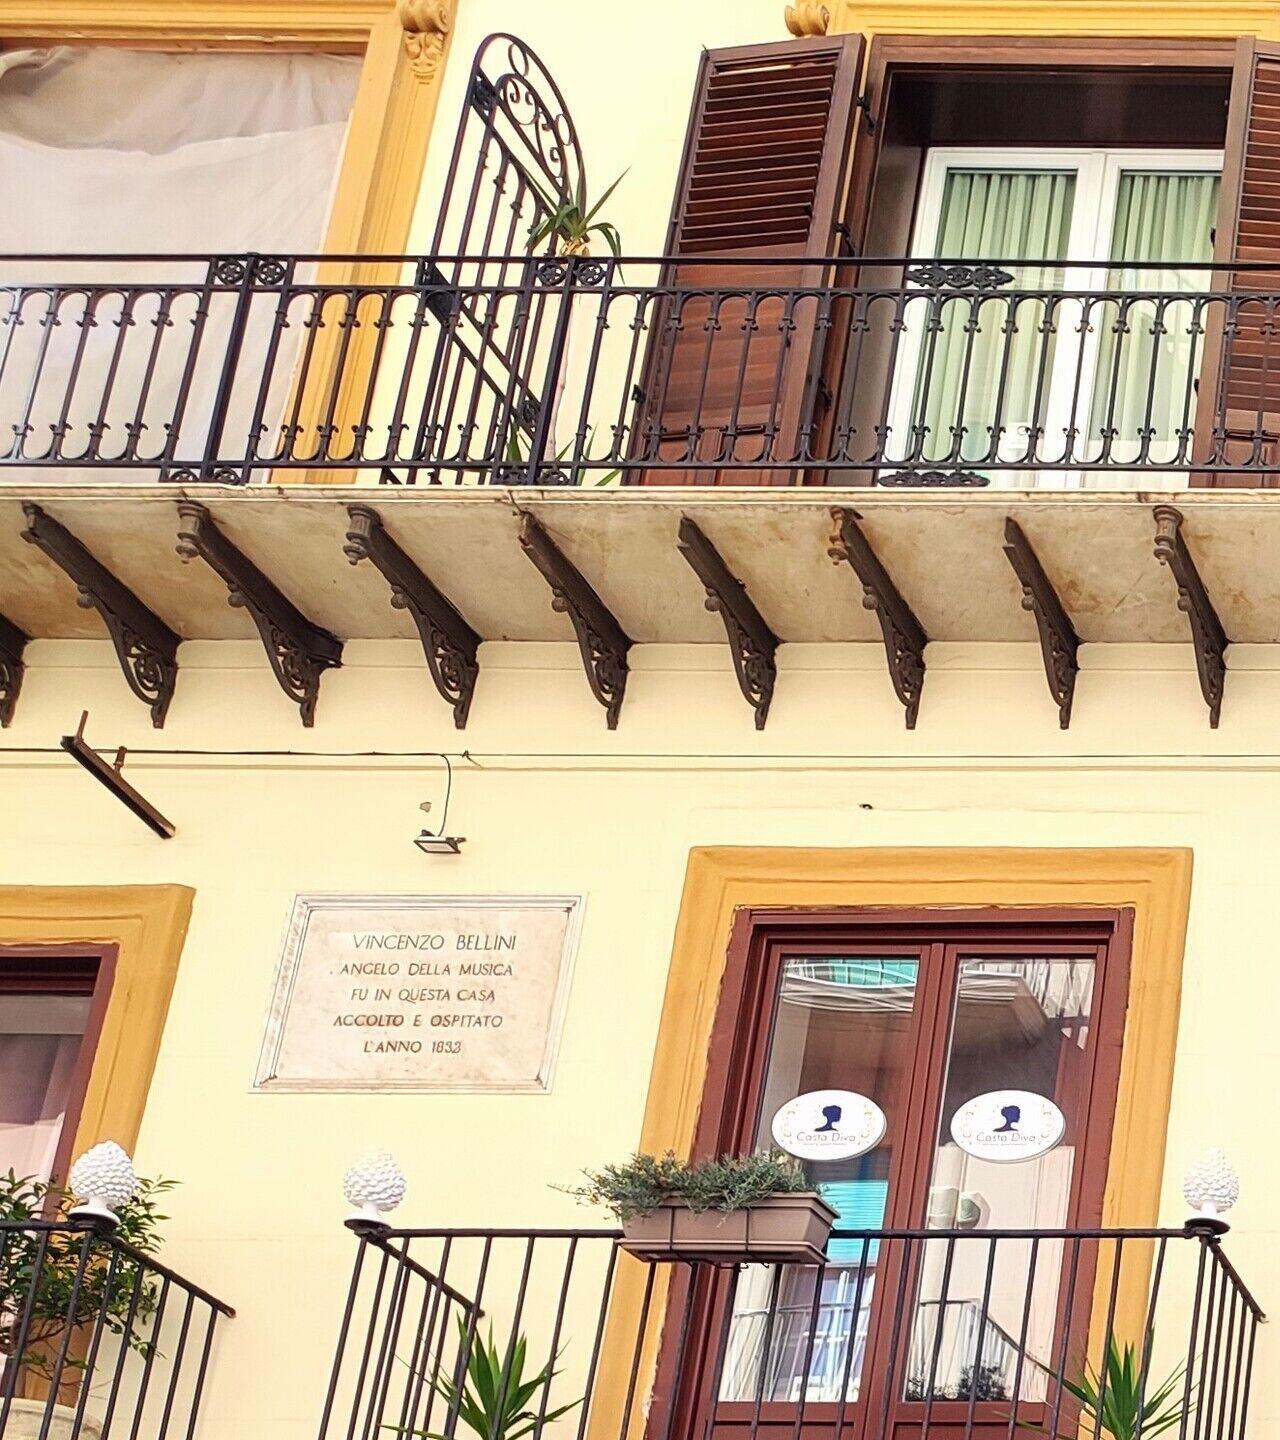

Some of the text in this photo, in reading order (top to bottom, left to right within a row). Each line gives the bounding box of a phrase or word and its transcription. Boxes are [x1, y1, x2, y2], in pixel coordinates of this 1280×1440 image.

[353, 935, 517, 950] VINCENZO BELLINI
[340, 963, 513, 976] ANGELO DELLA MUSICA
[351, 988, 495, 1004] FU IN QUESTA CASA
[333, 1014, 503, 1028] ACCOLTO E OSPITATO
[363, 1040, 422, 1053] L'ANNO
